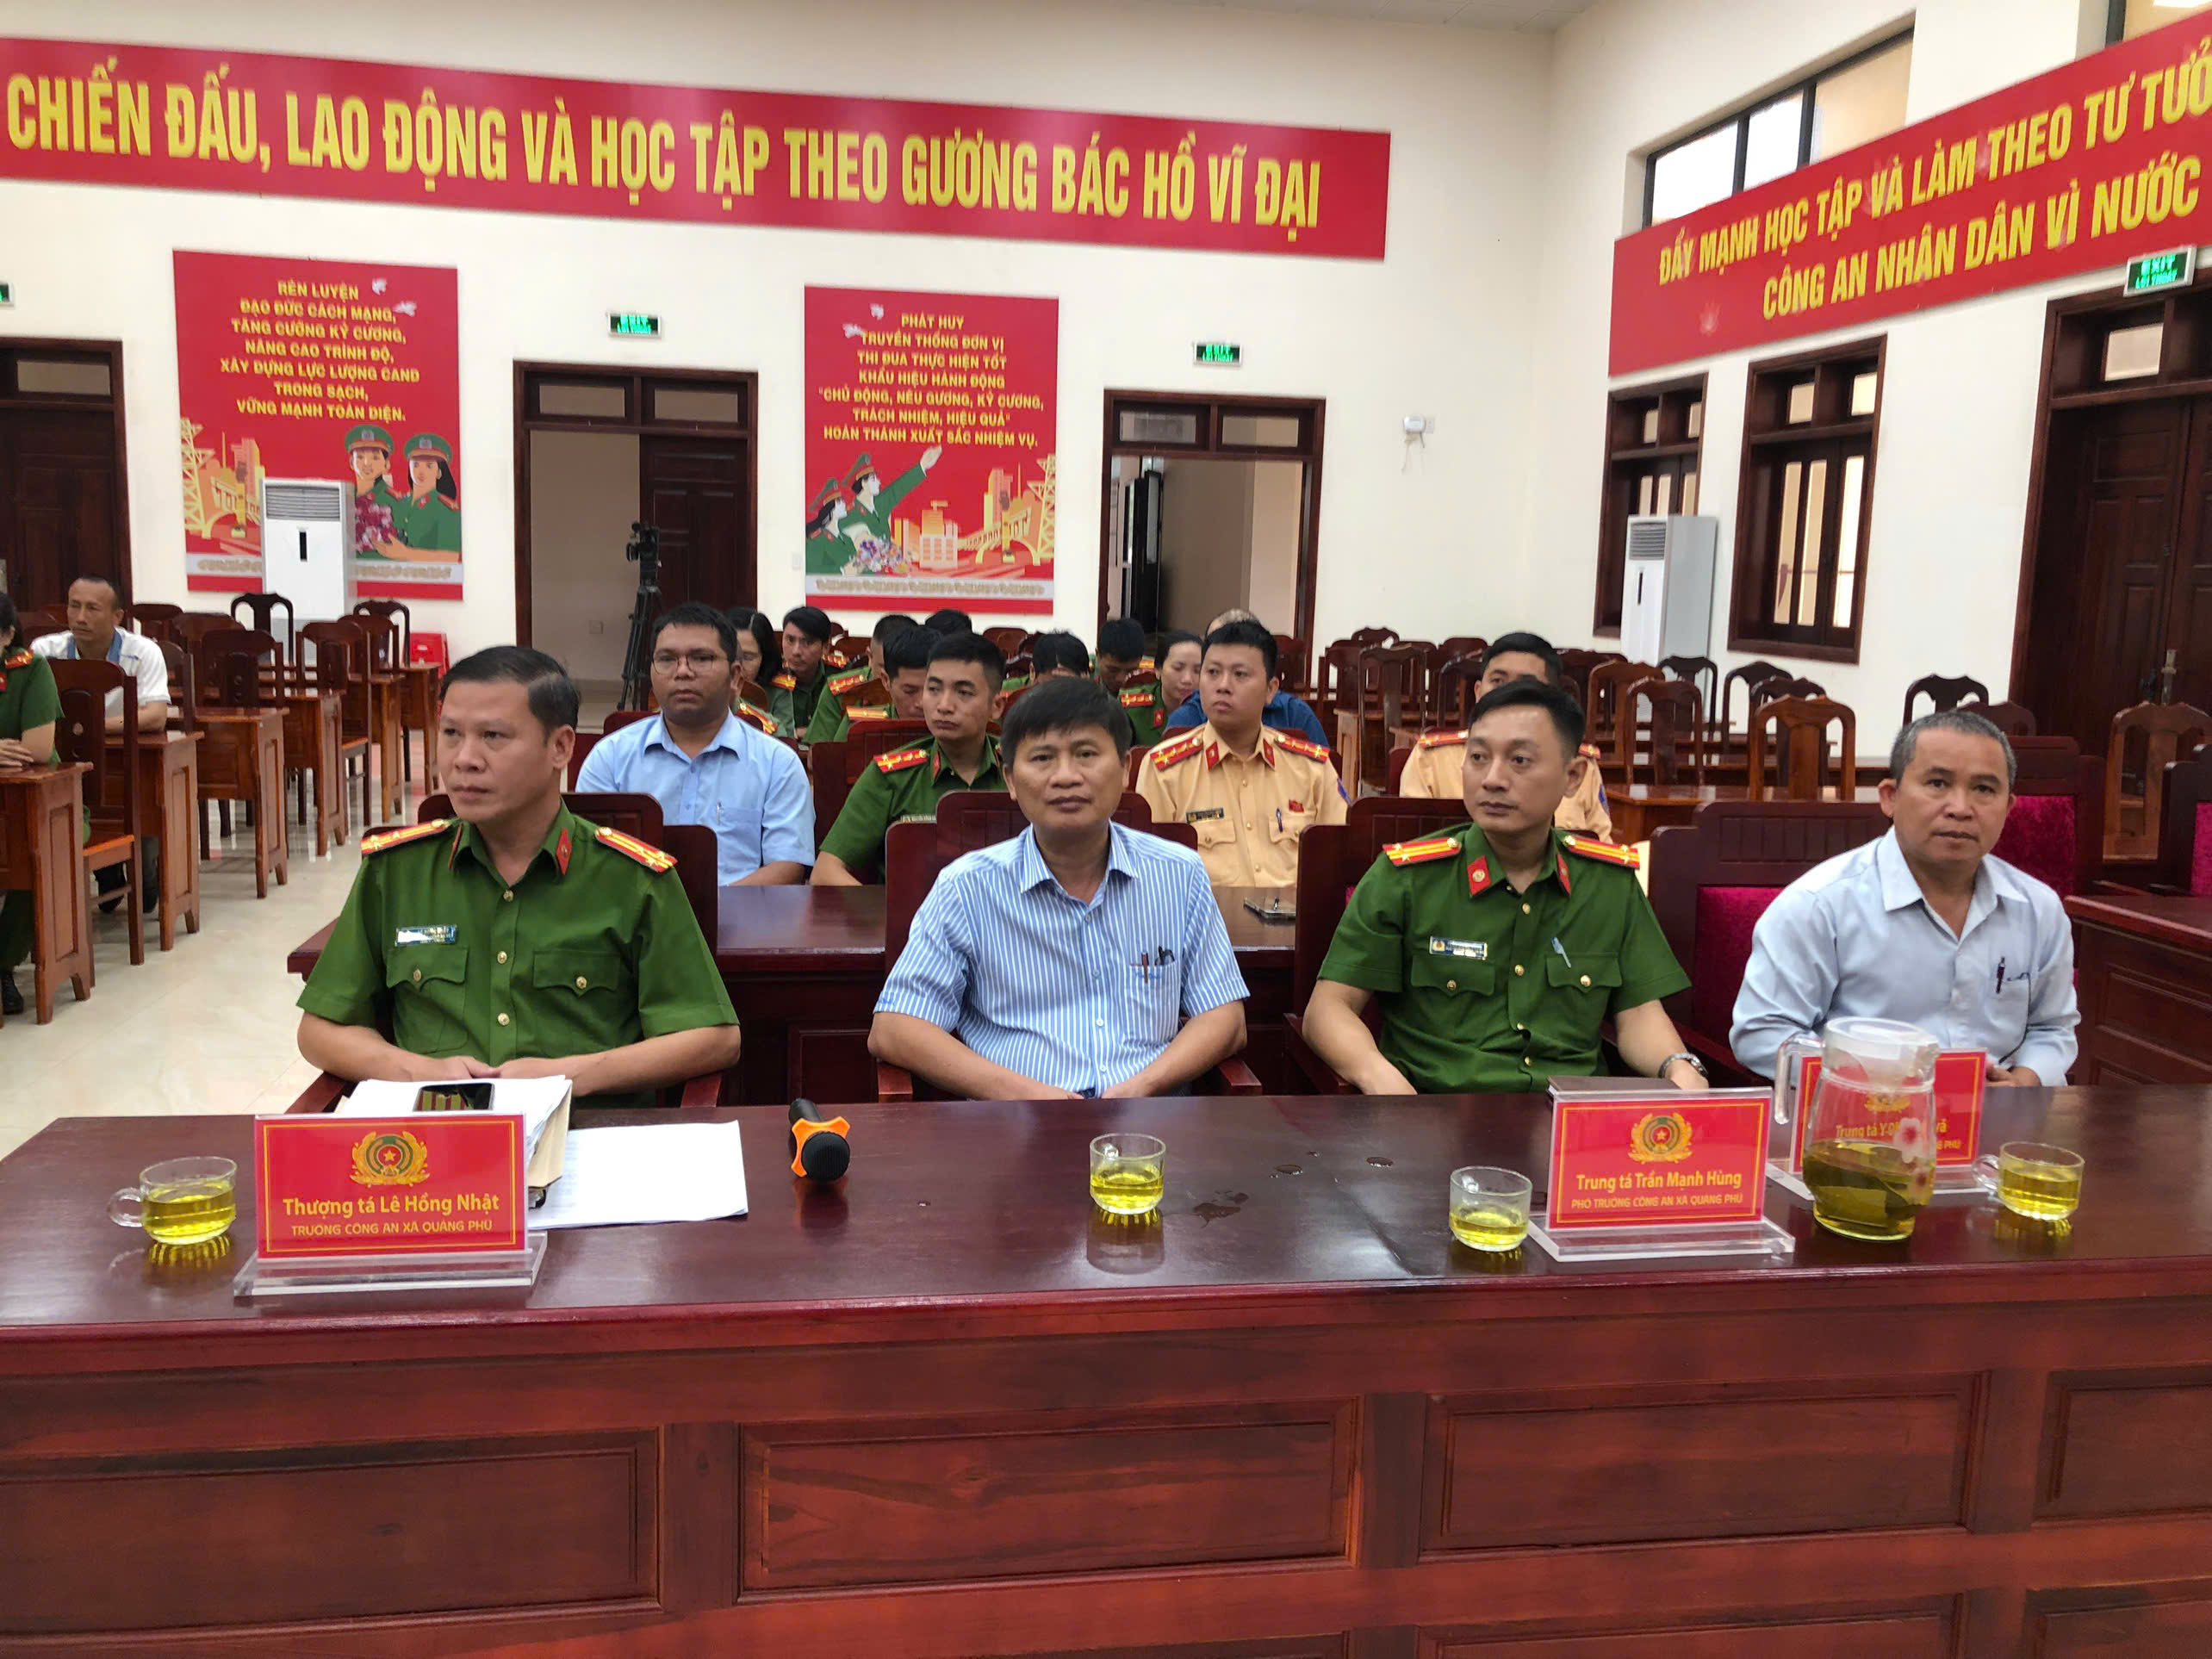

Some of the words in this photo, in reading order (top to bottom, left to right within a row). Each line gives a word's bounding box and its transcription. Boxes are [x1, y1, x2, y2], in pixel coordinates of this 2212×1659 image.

[8, 54, 152, 156] CHIẾN
[165, 62, 270, 173] ĐẤU,
[286, 90, 370, 171] LAO
[382, 86, 507, 192] ĐỘNG
[521, 96, 578, 186] VÀ
[591, 115, 675, 205] HỌC
[690, 109, 769, 210] TẬP
[784, 127, 887, 203] THEO
[902, 127, 1037, 212] GƯƠNG
[1052, 131, 1129, 217] BÁC
[1143, 131, 1196, 221] HỒ
[1209, 143, 1247, 223] VĨ
[1255, 157, 1320, 242] ĐẠI
[1659, 226, 1694, 286] ĐẨY
[1699, 216, 1759, 276] MẠNH
[1764, 197, 1809, 257] HỌC
[1817, 175, 1862, 241] TẬP
[1871, 154, 1903, 219] VÀ
[1911, 138, 1977, 207] LÀM
[1988, 103, 2072, 181] THEO
[2084, 70, 2137, 150] TƯ
[1763, 263, 1825, 320] CÔNG
[1831, 251, 1868, 304] AN
[1875, 222, 1957, 293] NHÂN
[1965, 200, 2035, 270] DÂN
[2047, 177, 2080, 250] VÌ
[2091, 150, 2201, 239] NƯỚC
[283, 1197, 353, 1218] Thượng
[357, 1196, 376, 1213] tá
[380, 1195, 400, 1213] Lê
[405, 1192, 451, 1215] Hồng
[457, 1192, 499, 1215] Nhật
[382, 1221, 399, 1233] AN
[1576, 1174, 1616, 1193] Trung
[1619, 1172, 1631, 1189] tá
[1668, 1170, 1703, 1190] Mạnh
